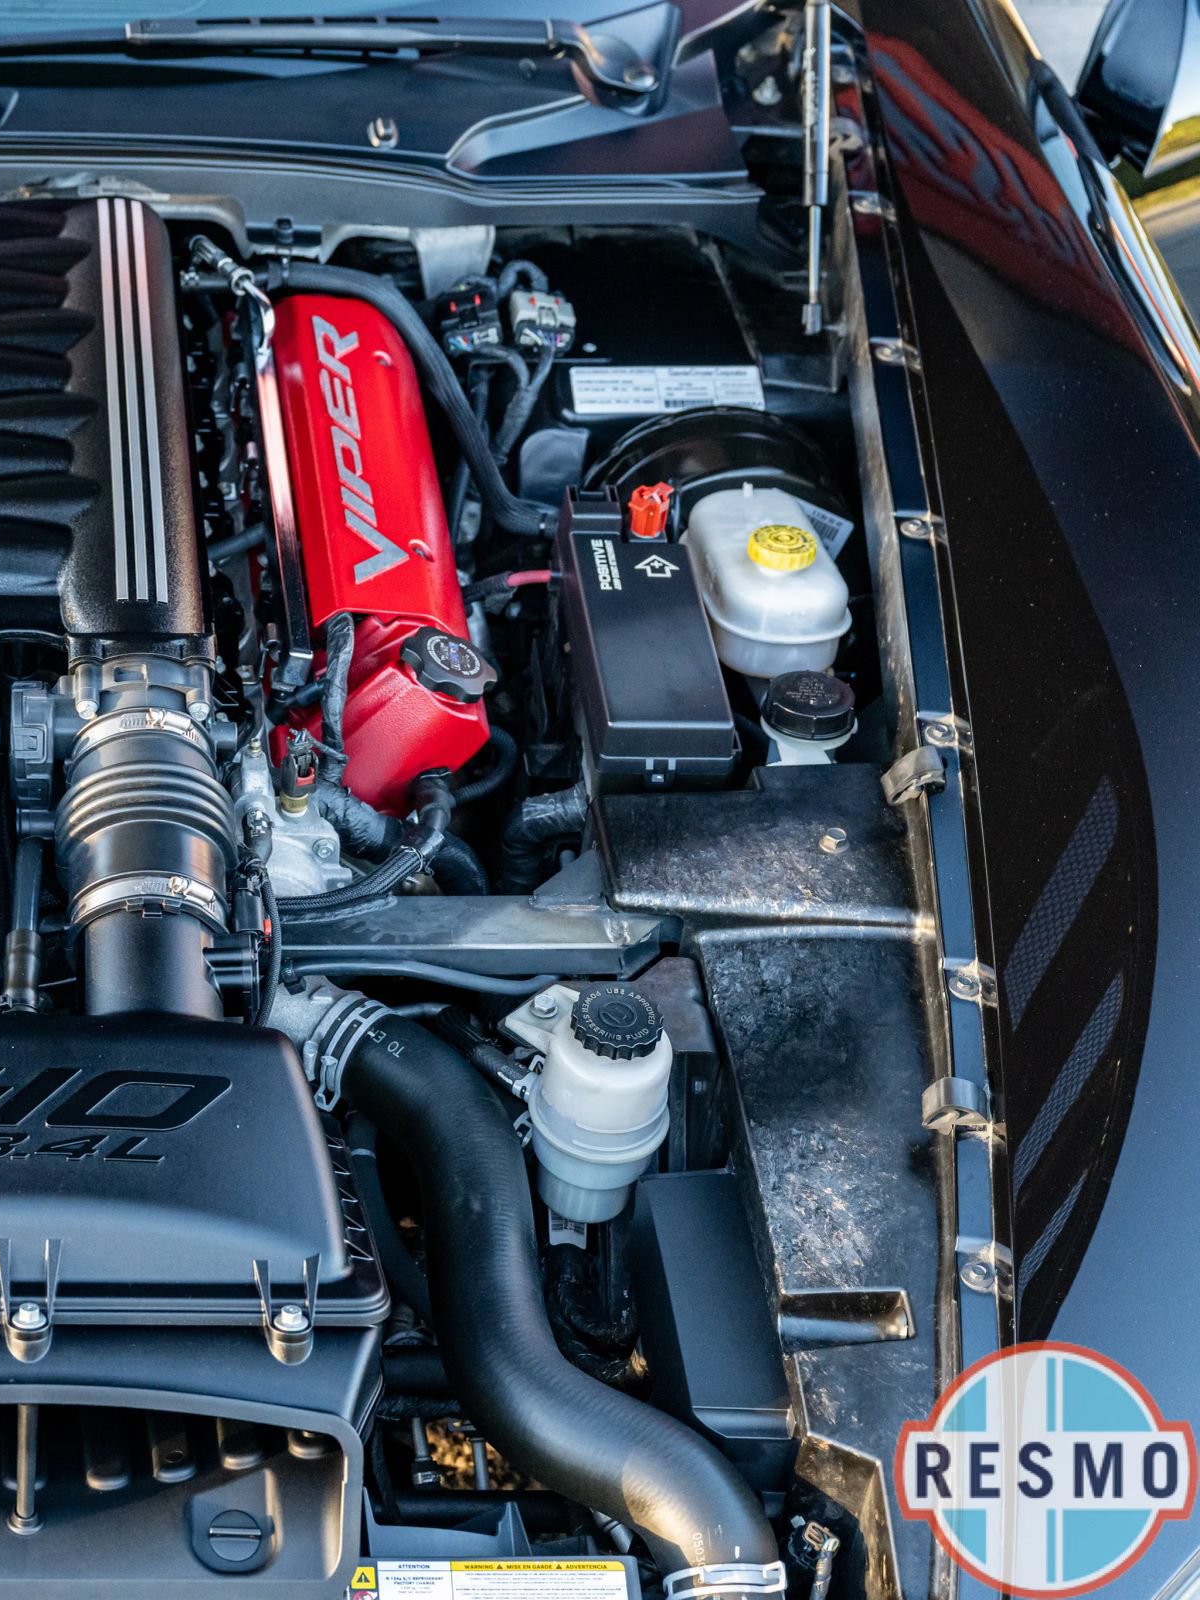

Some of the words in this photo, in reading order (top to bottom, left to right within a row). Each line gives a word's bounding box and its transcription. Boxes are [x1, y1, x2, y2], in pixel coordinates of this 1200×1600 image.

[311, 314, 410, 585] VIPER
[590, 538, 613, 591] POSITIVE
[581, 990, 602, 1013] POWER
[628, 991, 656, 1025] APPROVED
[582, 1014, 623, 1041] STEERING
[626, 1028, 650, 1041] FLUID
[387, 1040, 406, 1058] TO
